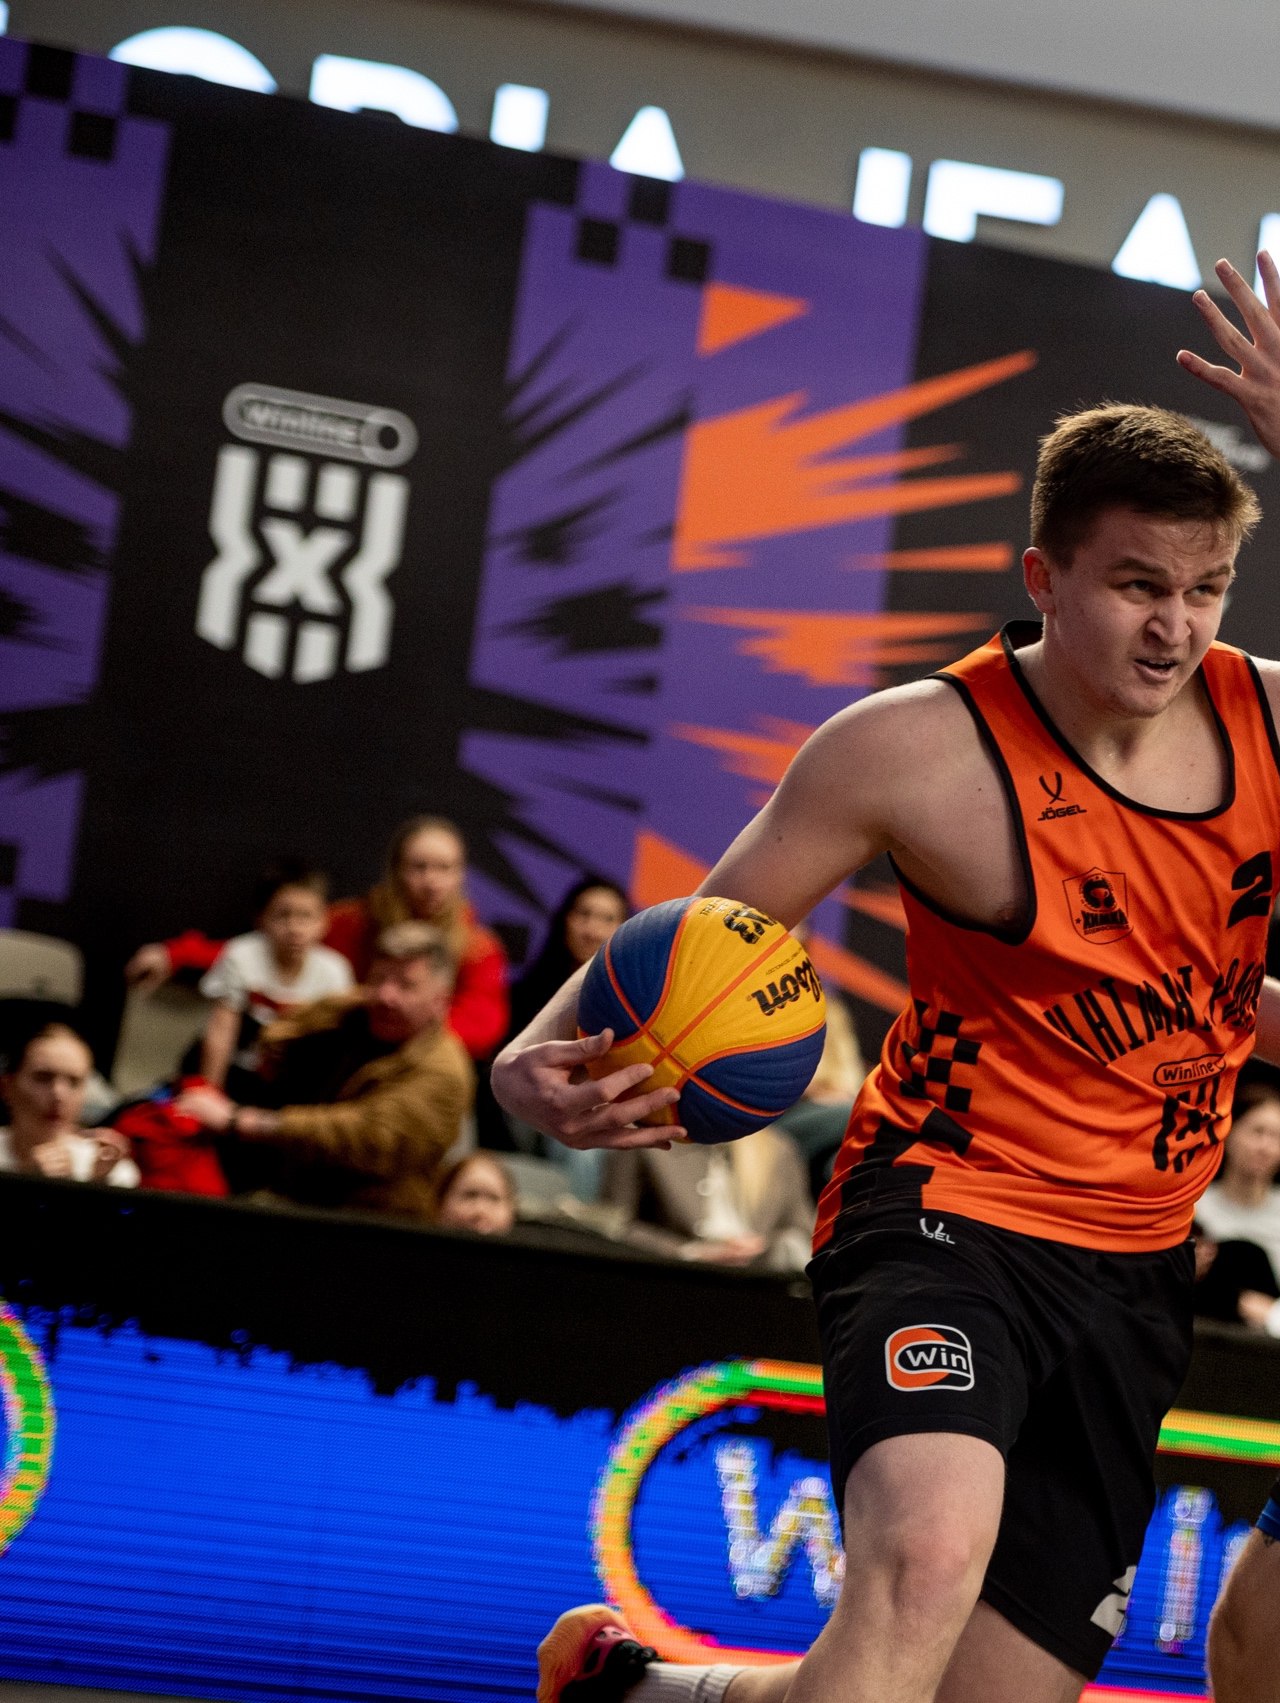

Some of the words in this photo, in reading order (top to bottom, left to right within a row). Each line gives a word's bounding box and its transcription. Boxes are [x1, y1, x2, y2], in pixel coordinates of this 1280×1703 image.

[1037, 804, 1088, 821] JÖGEL
[1227, 850, 1273, 929] 2
[1163, 1060, 1214, 1081] Winline
[906, 1347, 967, 1371] Win
